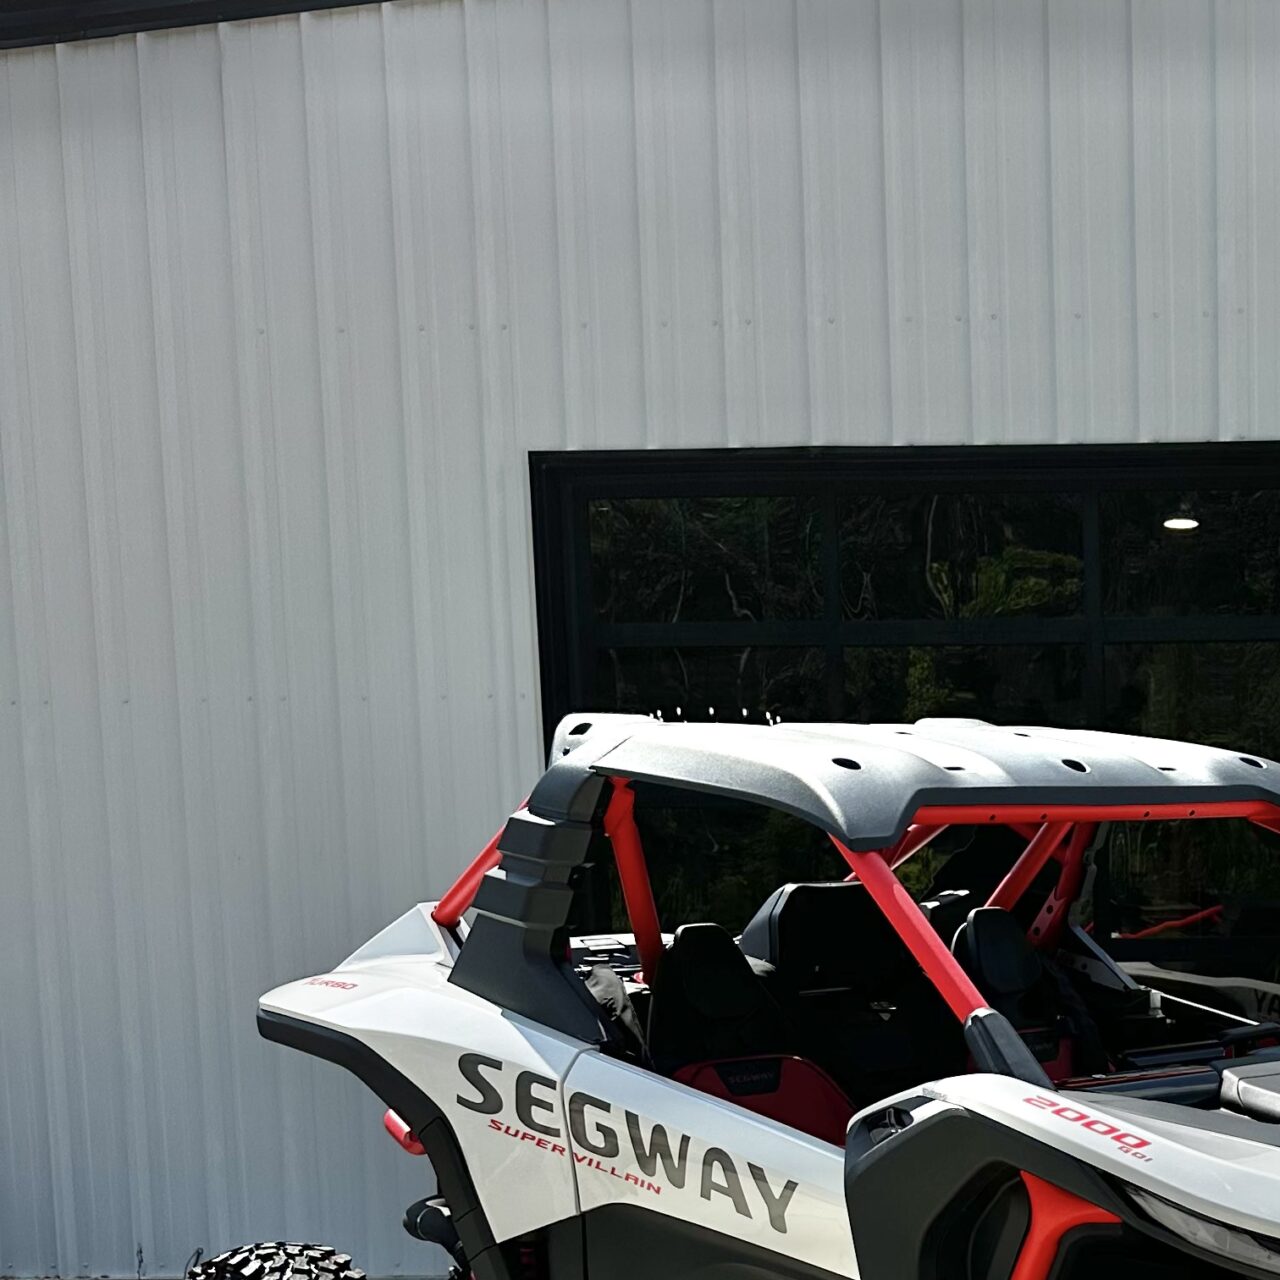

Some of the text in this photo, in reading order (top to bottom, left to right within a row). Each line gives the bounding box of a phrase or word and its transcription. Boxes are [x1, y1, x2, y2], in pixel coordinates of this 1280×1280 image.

[302, 977, 359, 991] TURBO
[456, 1052, 799, 1234] SEGWAY
[1022, 1095, 1152, 1149] 2000
[487, 1118, 662, 1195] SUPER VILLAIN
